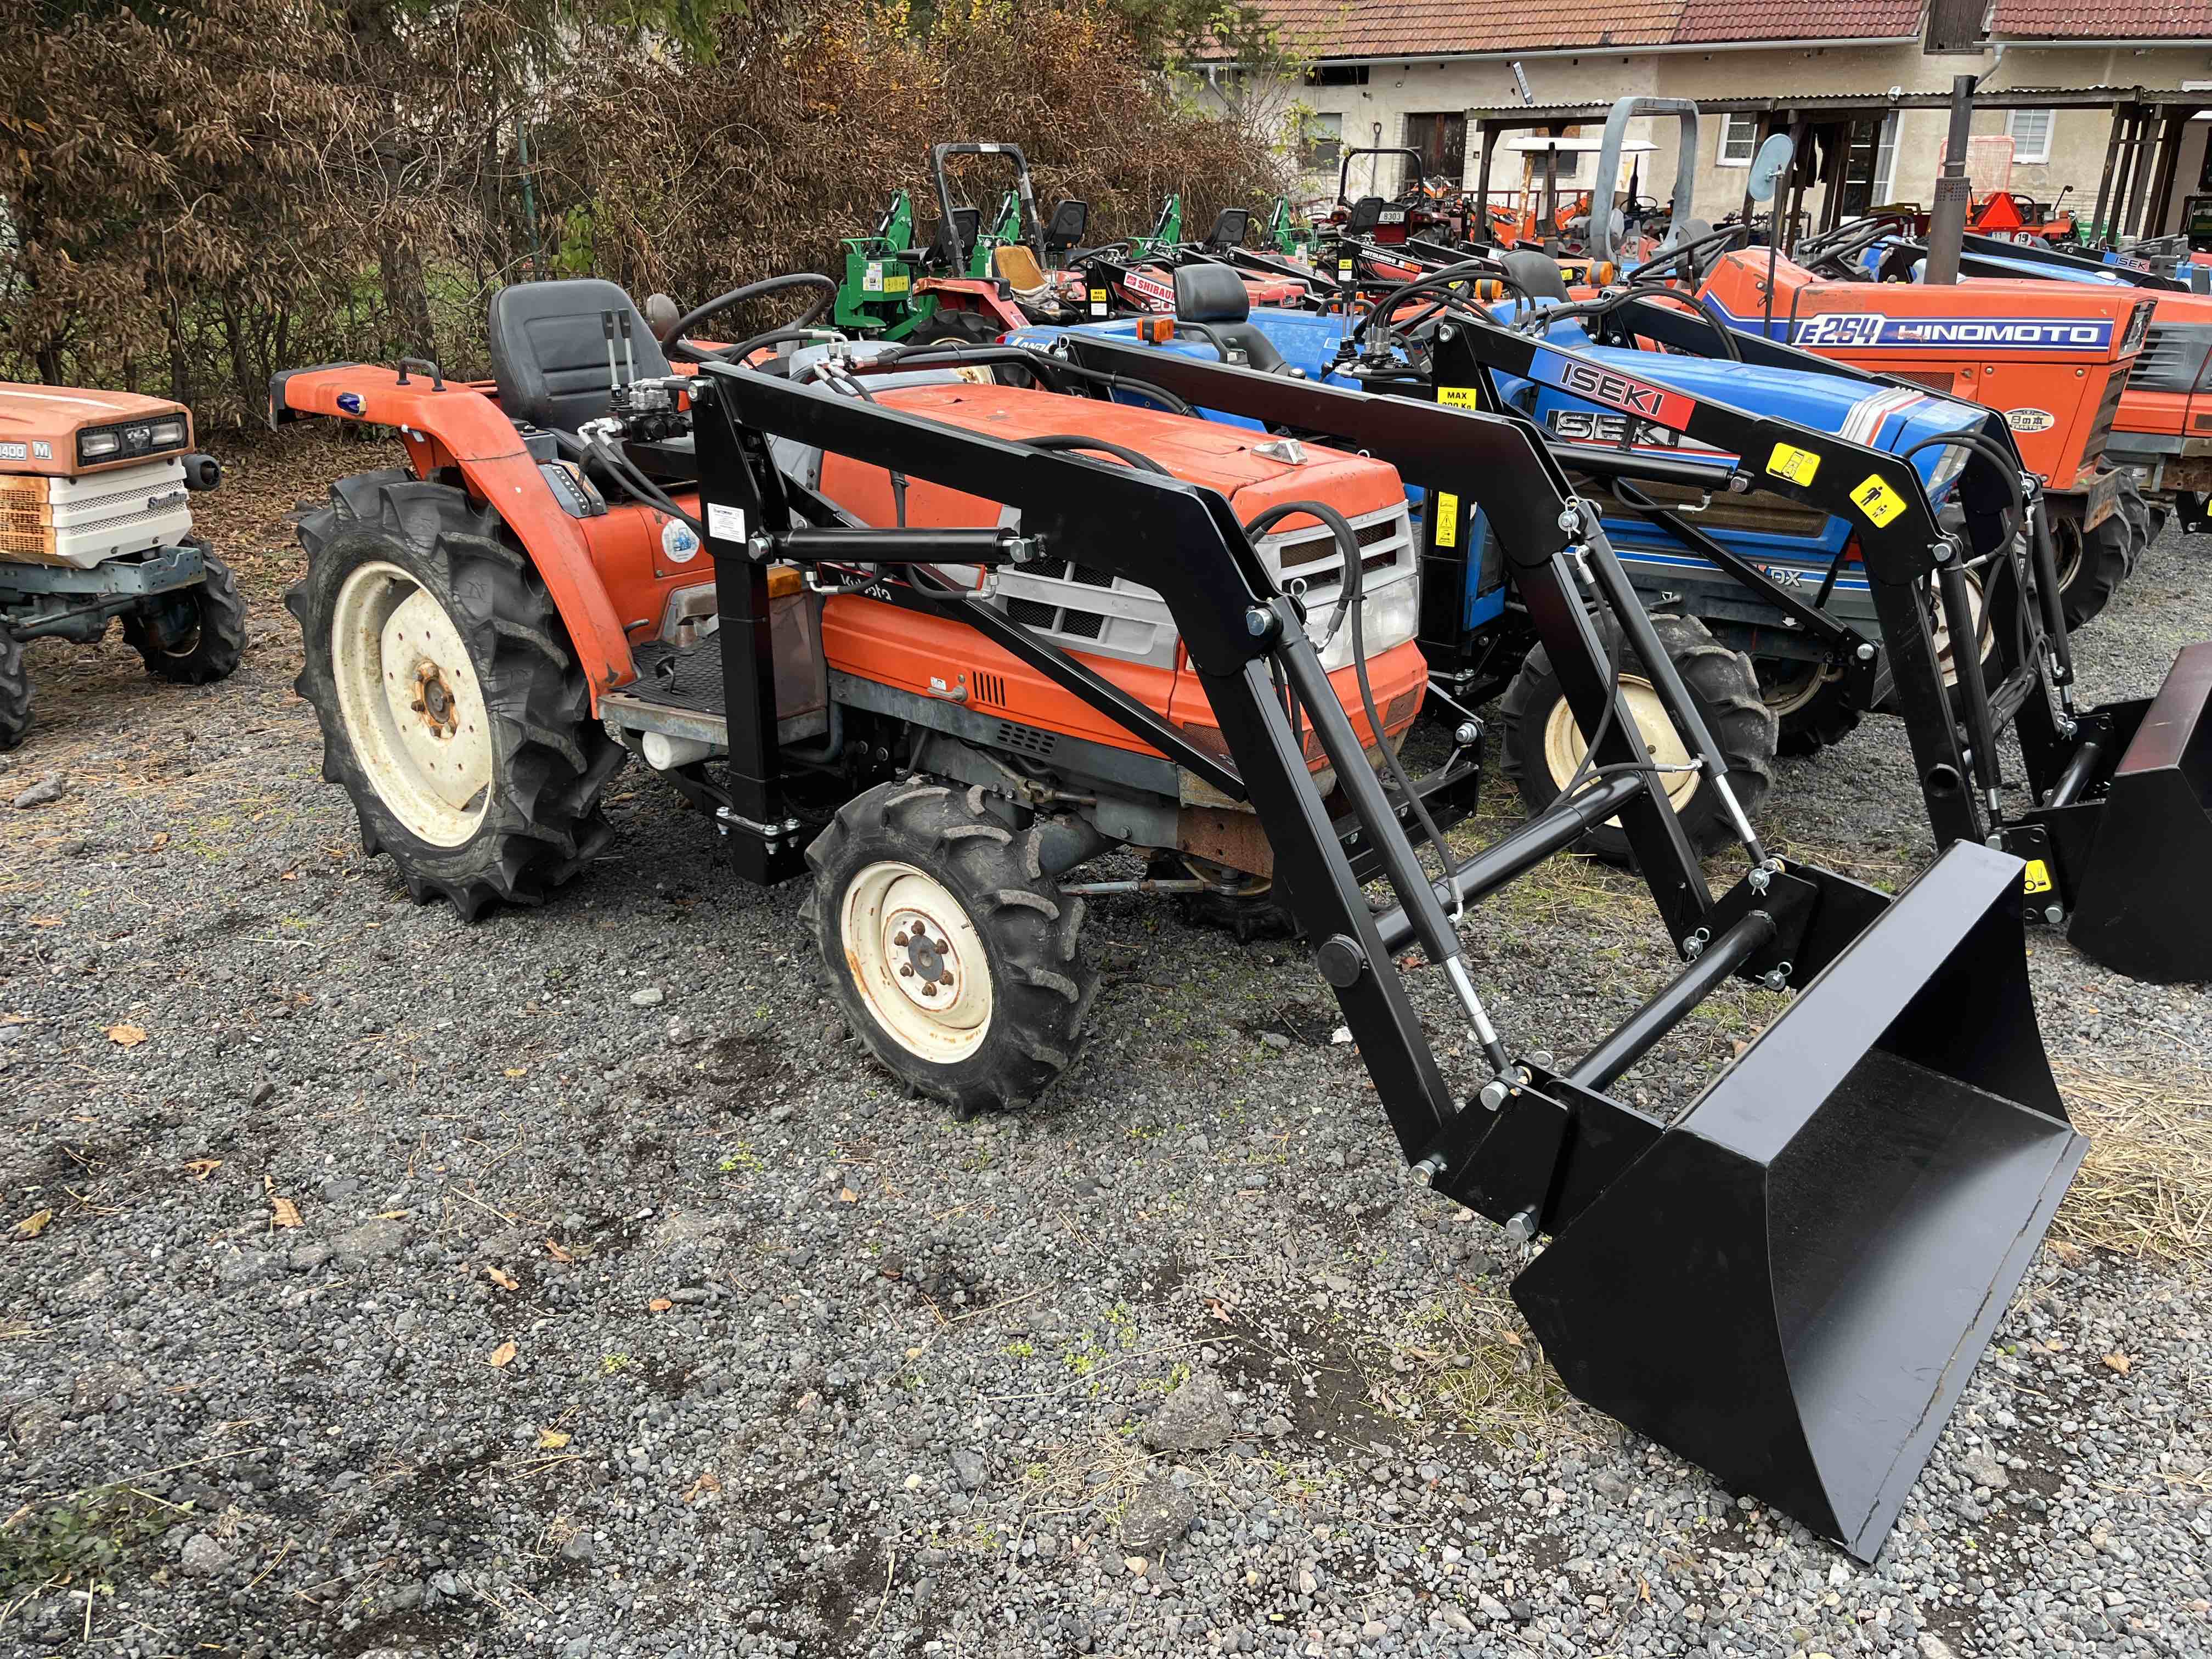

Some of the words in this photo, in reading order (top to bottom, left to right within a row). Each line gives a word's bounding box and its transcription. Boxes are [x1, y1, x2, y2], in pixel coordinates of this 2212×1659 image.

[1362, 249, 1396, 264] MITSUBISHI
[2115, 257, 2147, 270] ISEK
[1898, 325, 2098, 342] HINOMOTO
[1561, 362, 1664, 416] ISEKI
[35, 442, 49, 458] M
[1771, 569, 1800, 586] DX
